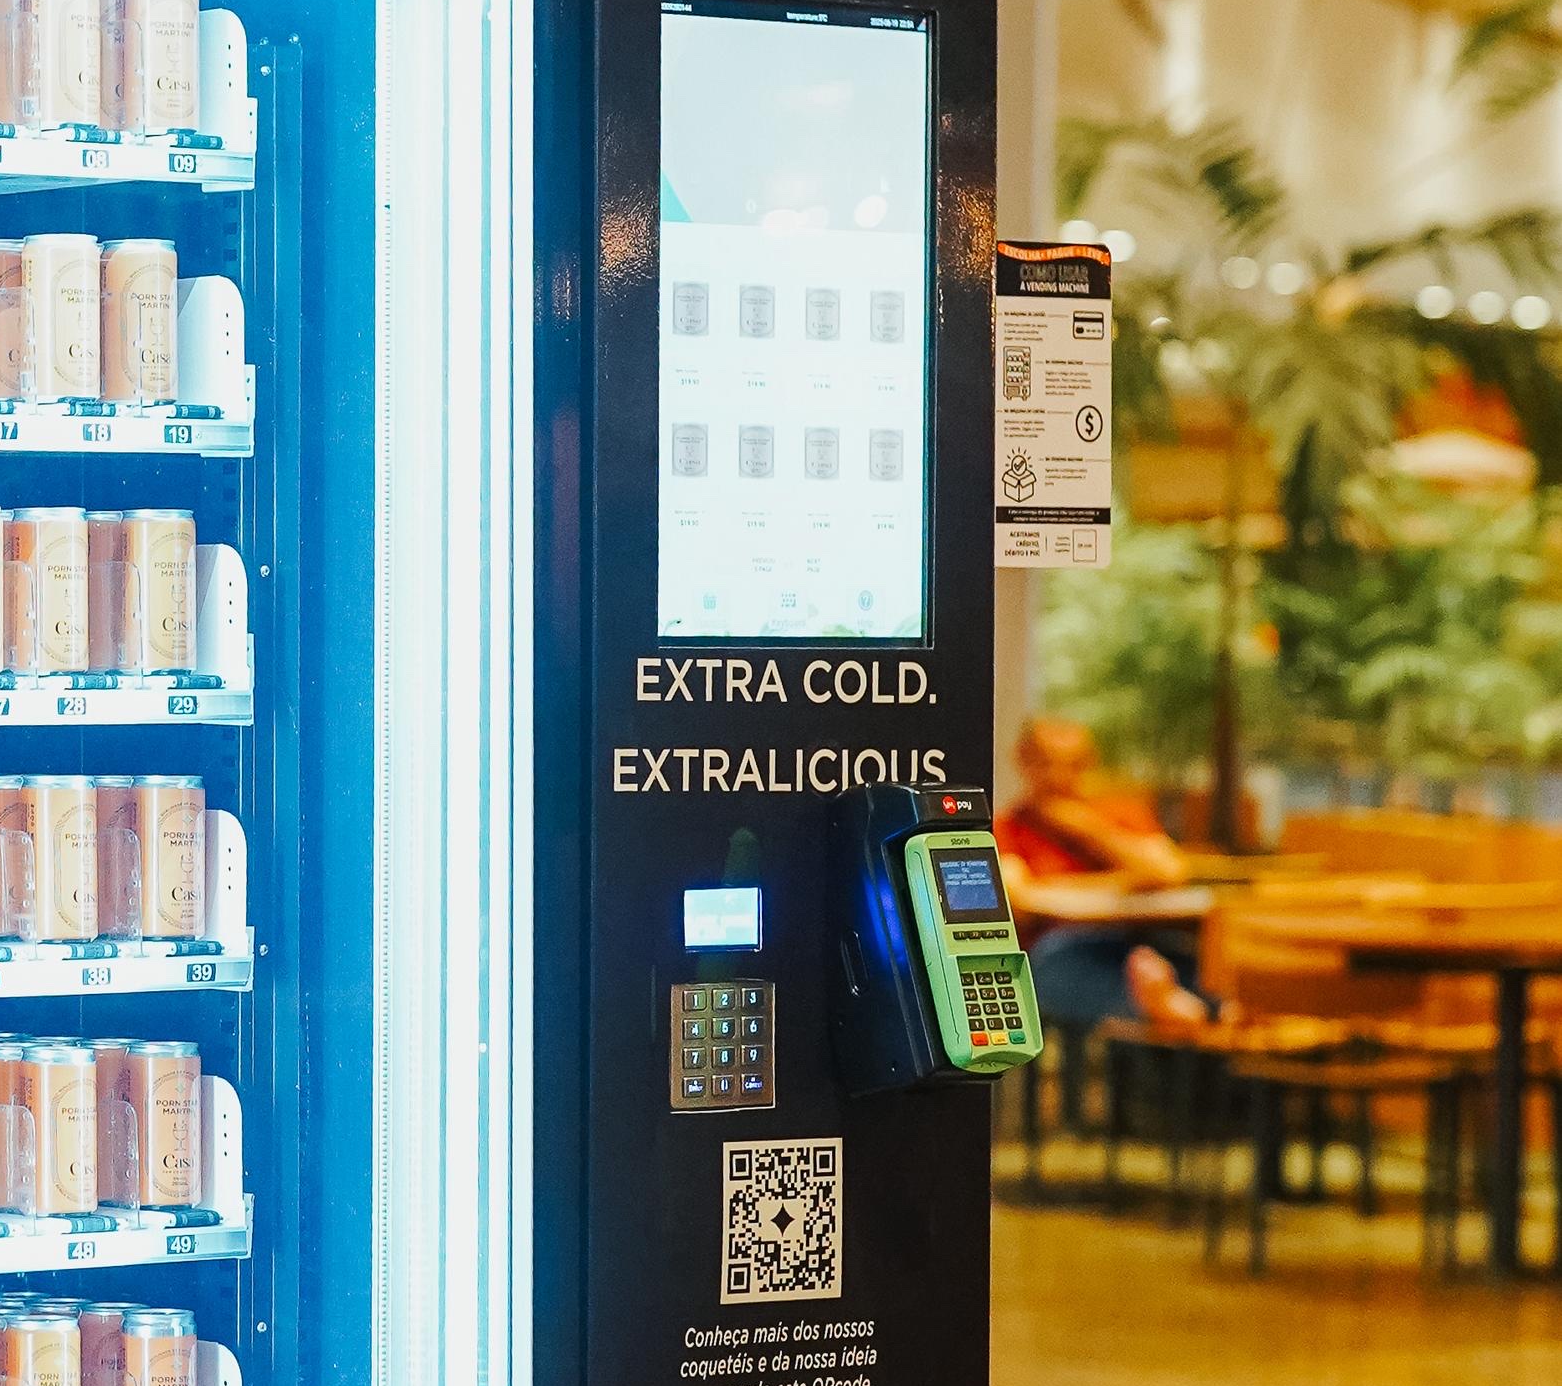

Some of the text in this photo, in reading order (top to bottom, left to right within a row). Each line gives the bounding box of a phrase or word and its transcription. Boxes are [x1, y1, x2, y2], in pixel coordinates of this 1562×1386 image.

[157, 76, 190, 92] Casa
[173, 155, 195, 173] 09
[87, 425, 110, 441] 18
[169, 427, 190, 443] 19
[637, 658, 937, 704] EXTRA COLD.
[63, 698, 85, 714] 28
[173, 697, 195, 713] 29
[612, 748, 946, 793] EXTRALICIOUS
[87, 968, 109, 984] 38
[191, 965, 214, 980] 39
[721, 994, 728, 1006] 2
[750, 992, 756, 1003] 3
[692, 1020, 757, 1035] 4 5 6
[692, 1052, 699, 1064] 7
[750, 1049, 757, 1061] 9
[163, 1154, 194, 1169] Casa
[72, 1242, 94, 1259] 48
[171, 1237, 192, 1253] 49
[684, 1320, 875, 1349] Conheça mais dos nossos
[680, 1345, 878, 1380] coquetéis e da nossa ideia
